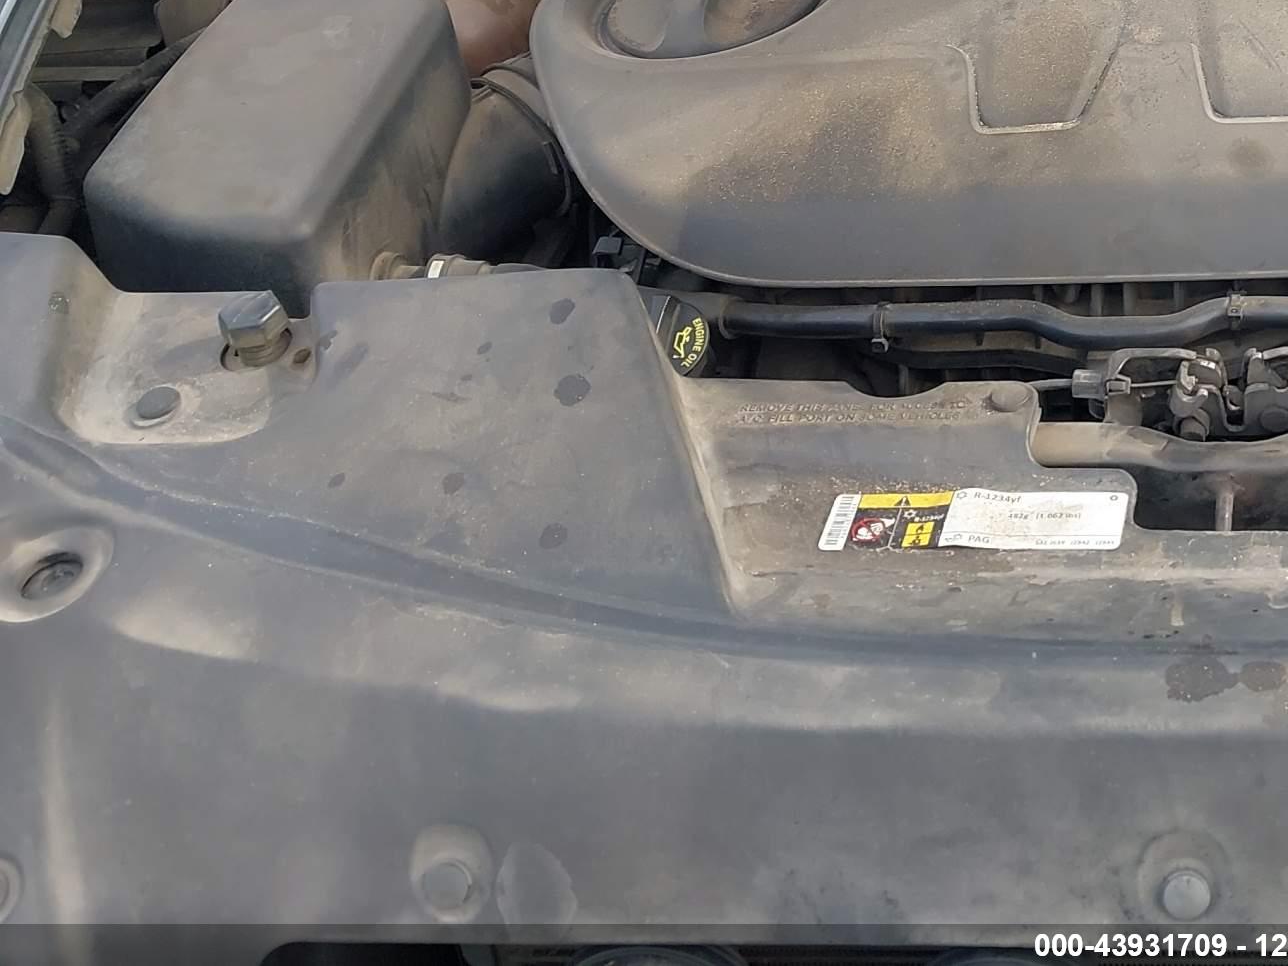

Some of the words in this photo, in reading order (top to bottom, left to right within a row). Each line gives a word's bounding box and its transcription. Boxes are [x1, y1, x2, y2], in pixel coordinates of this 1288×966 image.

[692, 317, 705, 352] ENGINE
[680, 353, 698, 368] OIL
[740, 401, 793, 412] REMOVE
[796, 402, 825, 412] THIS
[769, 413, 794, 424] FILL
[798, 413, 832, 423] PORT
[836, 413, 858, 422] ON
[973, 491, 1022, 505] R-1234yf
[968, 535, 991, 544] PAG
